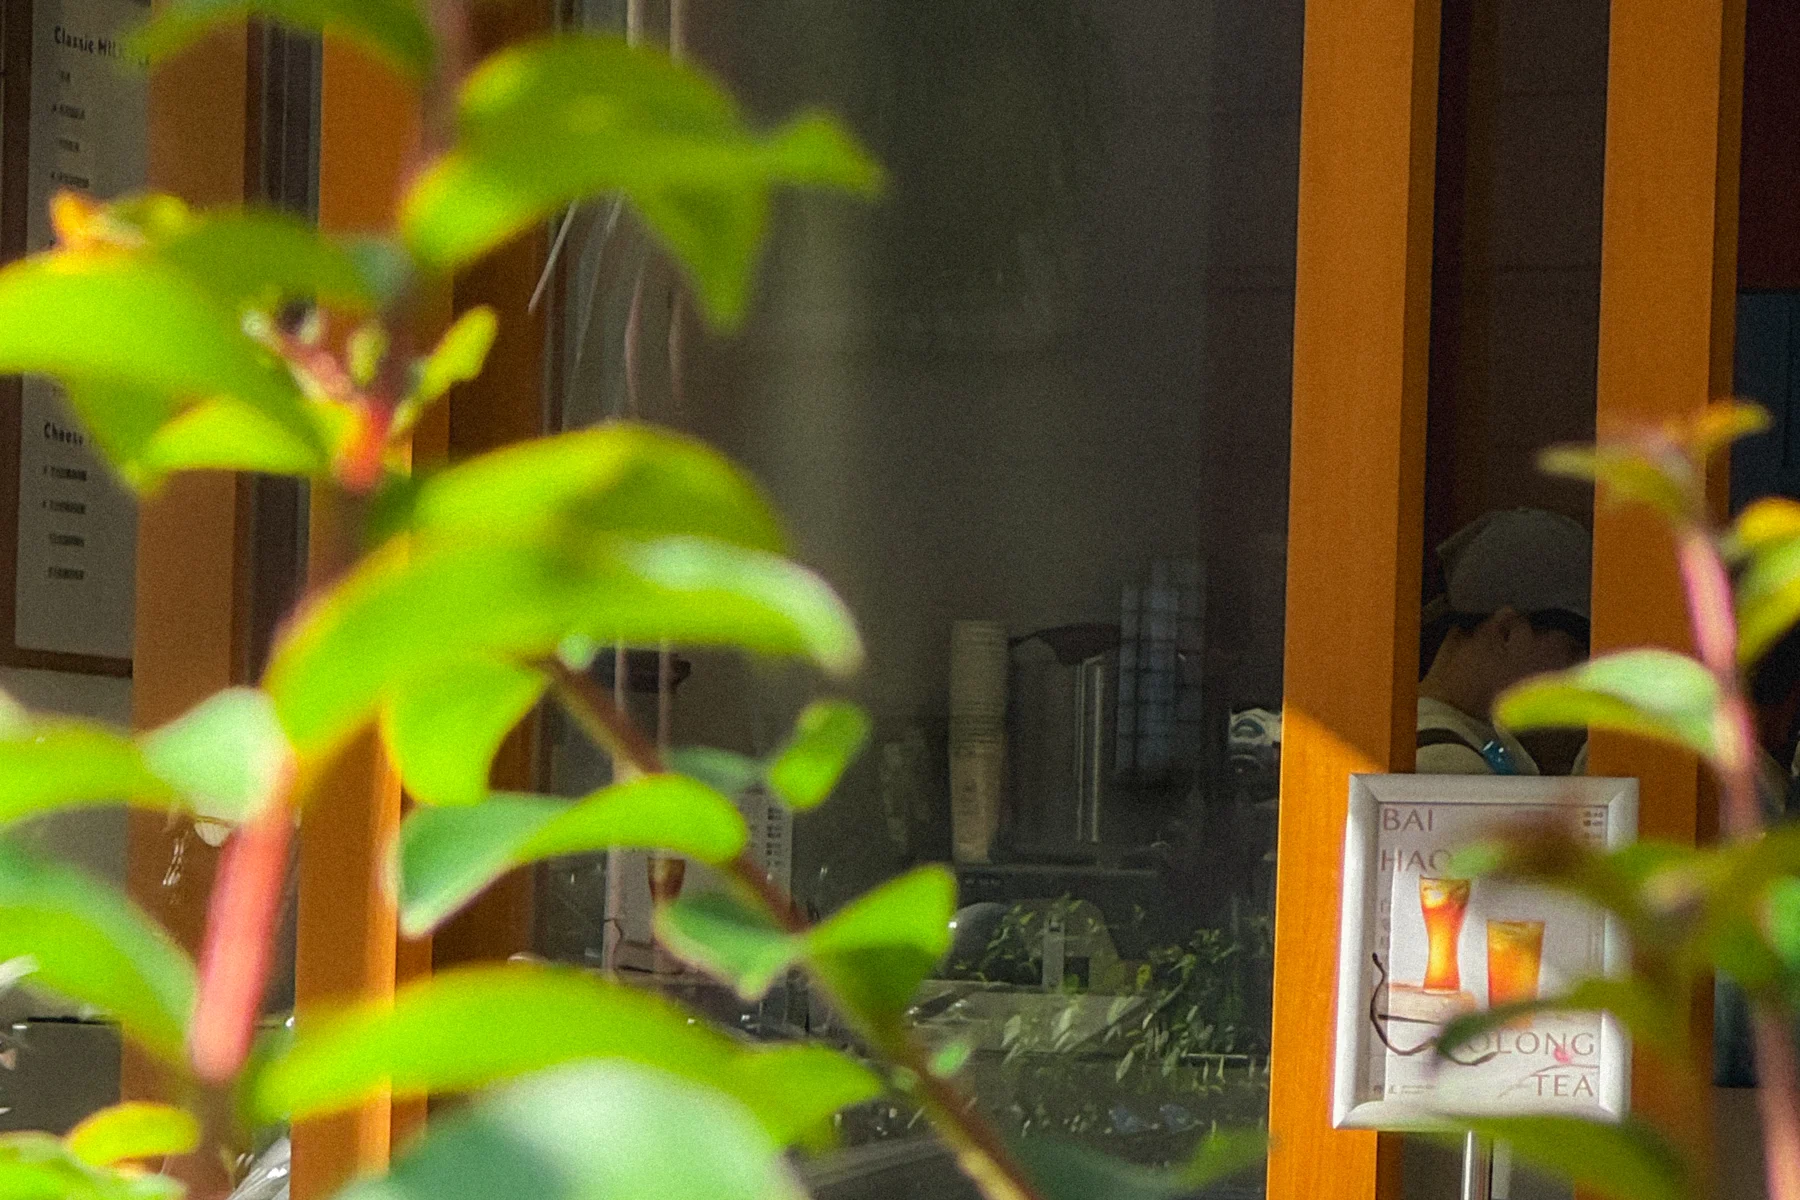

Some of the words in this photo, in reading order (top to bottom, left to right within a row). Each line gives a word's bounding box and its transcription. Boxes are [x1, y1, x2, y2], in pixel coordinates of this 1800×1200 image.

[1383, 808, 1433, 831] BAI
[1466, 1029, 1595, 1056] OLONG
[1531, 1074, 1594, 1097] TEA
